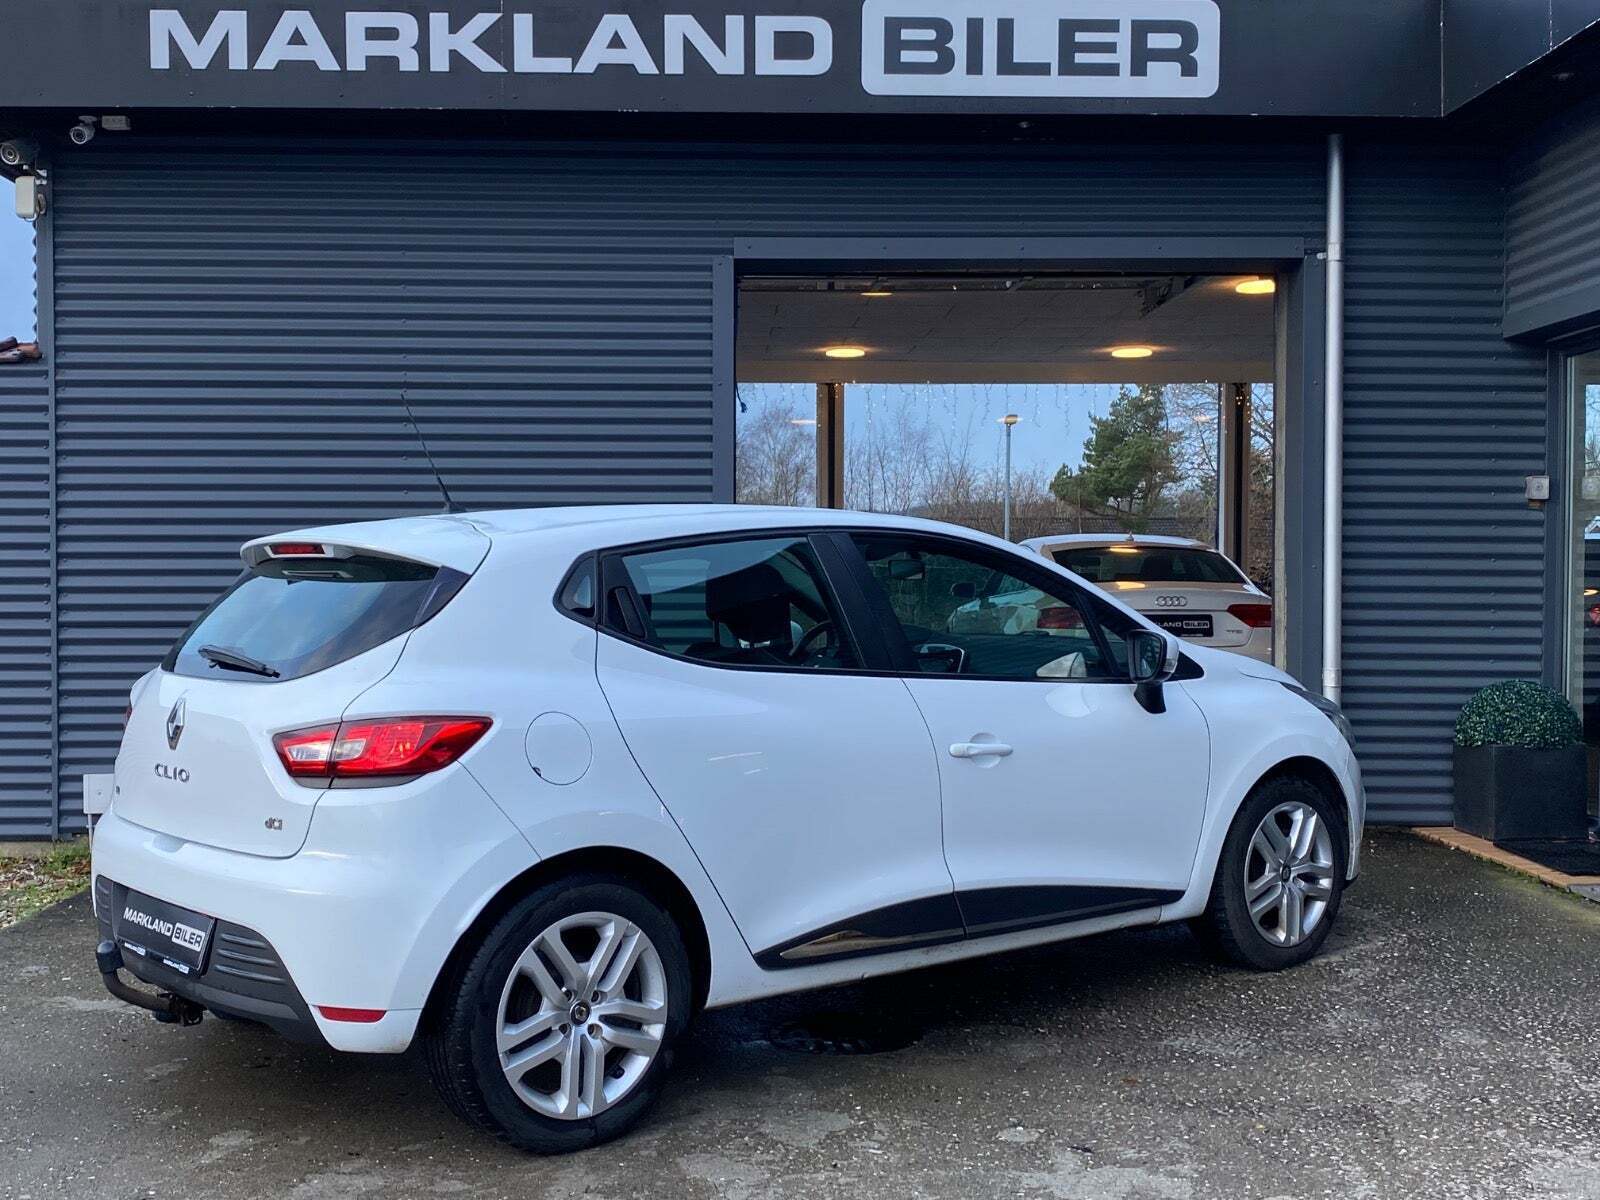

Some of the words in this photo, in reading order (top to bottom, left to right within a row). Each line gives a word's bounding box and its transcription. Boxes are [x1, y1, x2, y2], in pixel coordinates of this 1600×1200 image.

[149, 10, 833, 76] MARKLAND
[883, 16, 1200, 78] BILER
[154, 763, 190, 782] CLIO
[123, 907, 173, 936] MARKLAND
[174, 926, 203, 948] BILER
